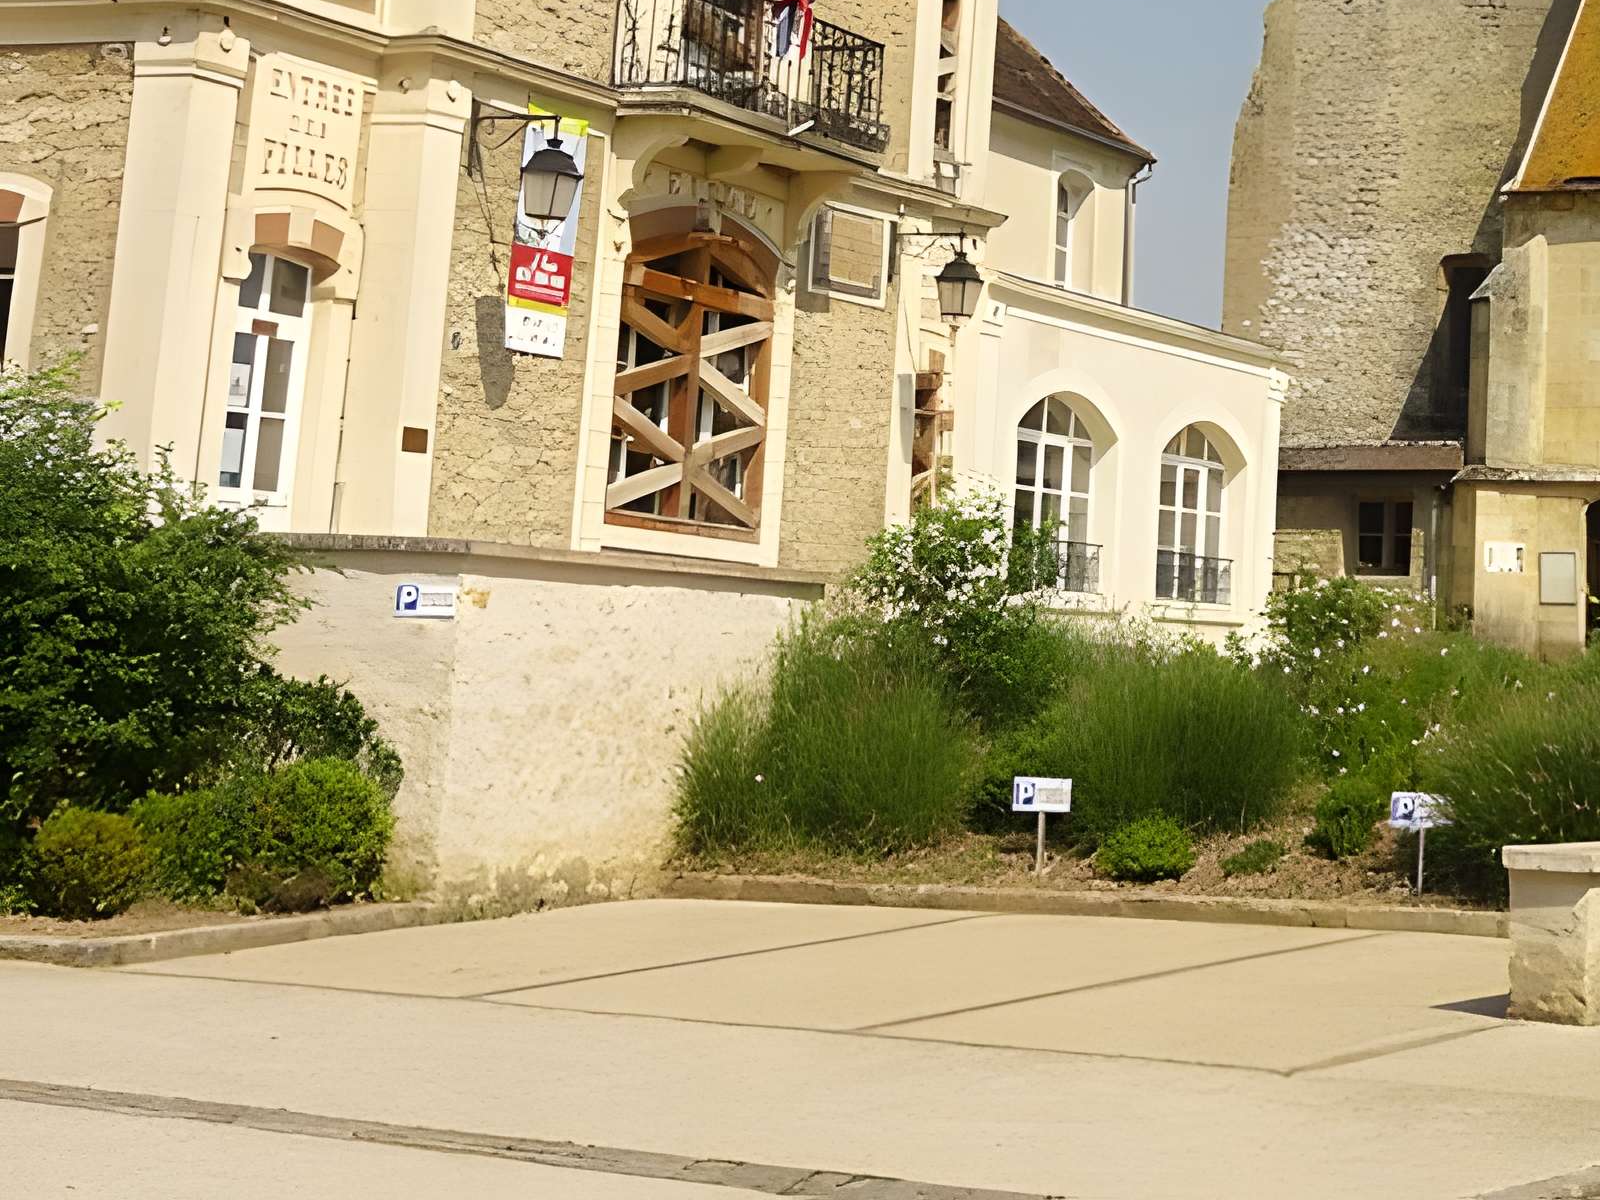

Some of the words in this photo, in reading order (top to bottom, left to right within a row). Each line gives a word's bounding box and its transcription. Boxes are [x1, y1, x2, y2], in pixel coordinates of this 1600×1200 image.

[261, 137, 349, 190] FILLES
[399, 585, 419, 610] P
[1018, 781, 1035, 805] P
